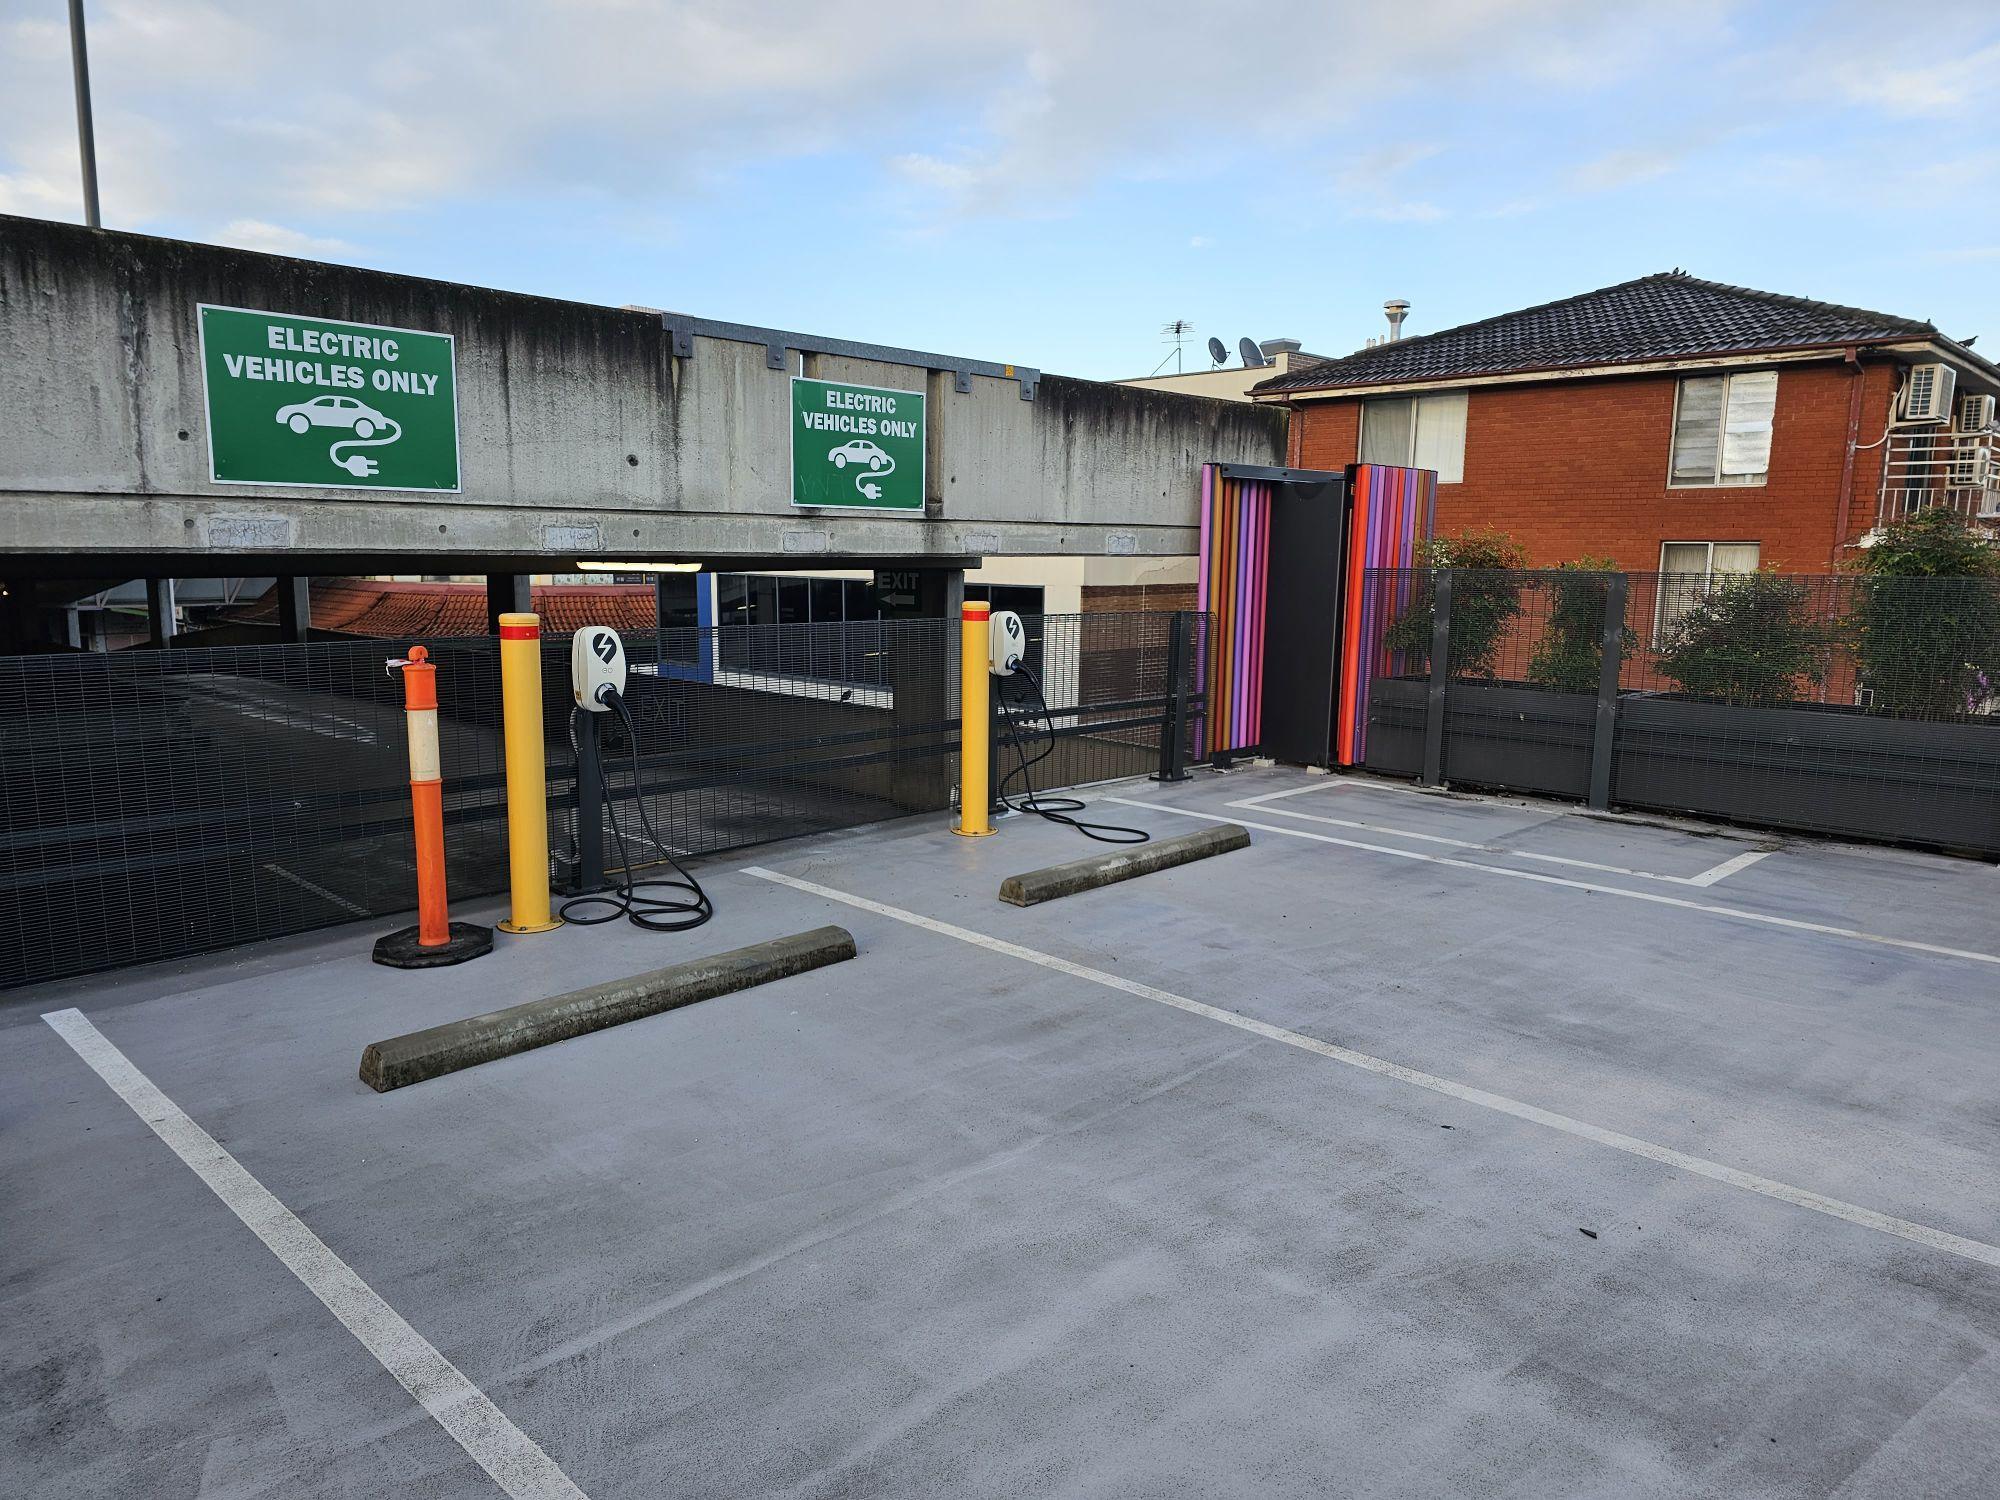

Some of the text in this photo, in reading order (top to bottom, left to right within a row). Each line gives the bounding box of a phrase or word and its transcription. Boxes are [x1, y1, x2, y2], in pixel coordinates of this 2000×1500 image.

[267, 325, 399, 361] ELECTRIC
[222, 353, 438, 396] VEHICLES ONLY
[826, 390, 897, 414] ELECTRIC
[802, 411, 917, 438] VEHICLES ONLY
[878, 571, 919, 590] EXIT
